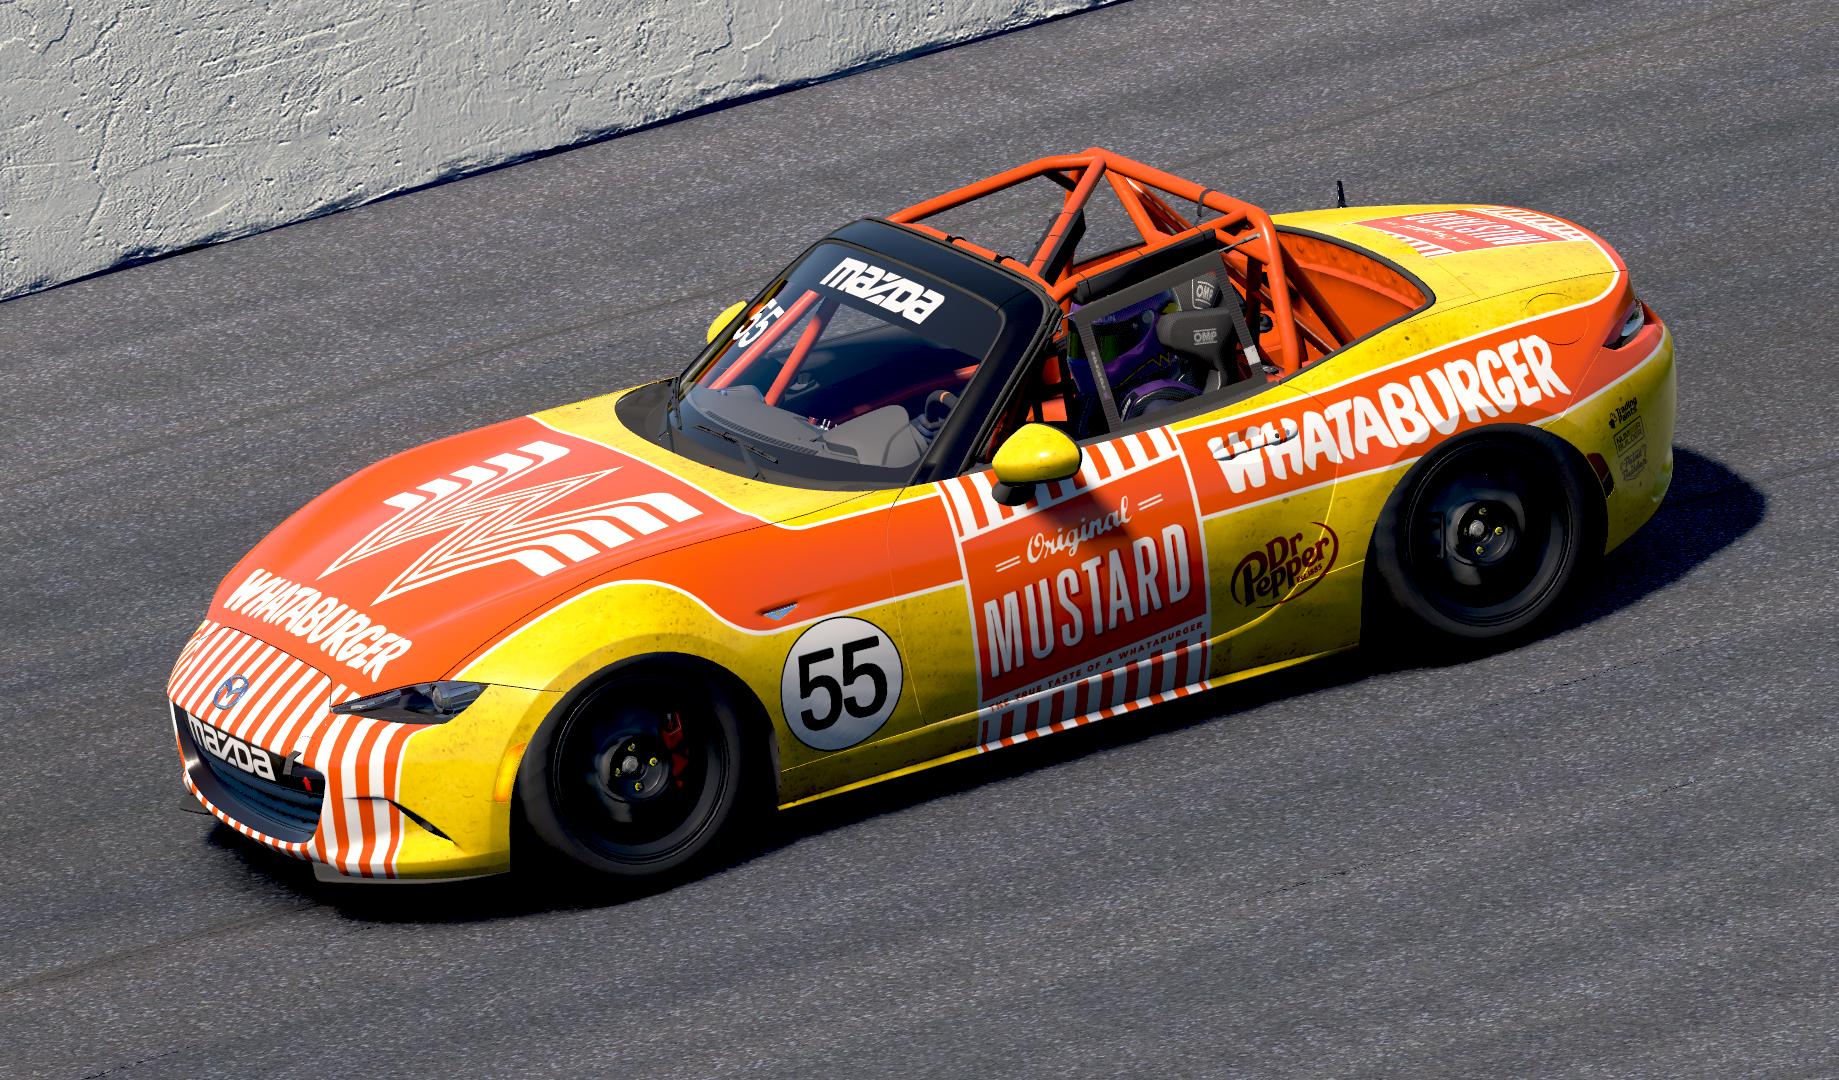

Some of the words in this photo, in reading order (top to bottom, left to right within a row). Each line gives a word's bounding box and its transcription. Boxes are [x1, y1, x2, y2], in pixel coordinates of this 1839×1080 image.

[733, 298, 785, 348] 55
[1193, 330, 1217, 343] OMP
[1206, 334, 1572, 493] WHATABURGER
[1026, 495, 1132, 564] Original
[1265, 533, 1303, 573] Dr
[984, 523, 1192, 680] MUSTARD
[1231, 537, 1330, 607] Pepper
[222, 569, 413, 682] WHATABURGER
[1118, 621, 1203, 660] WHATABURGER
[798, 636, 889, 732] 55
